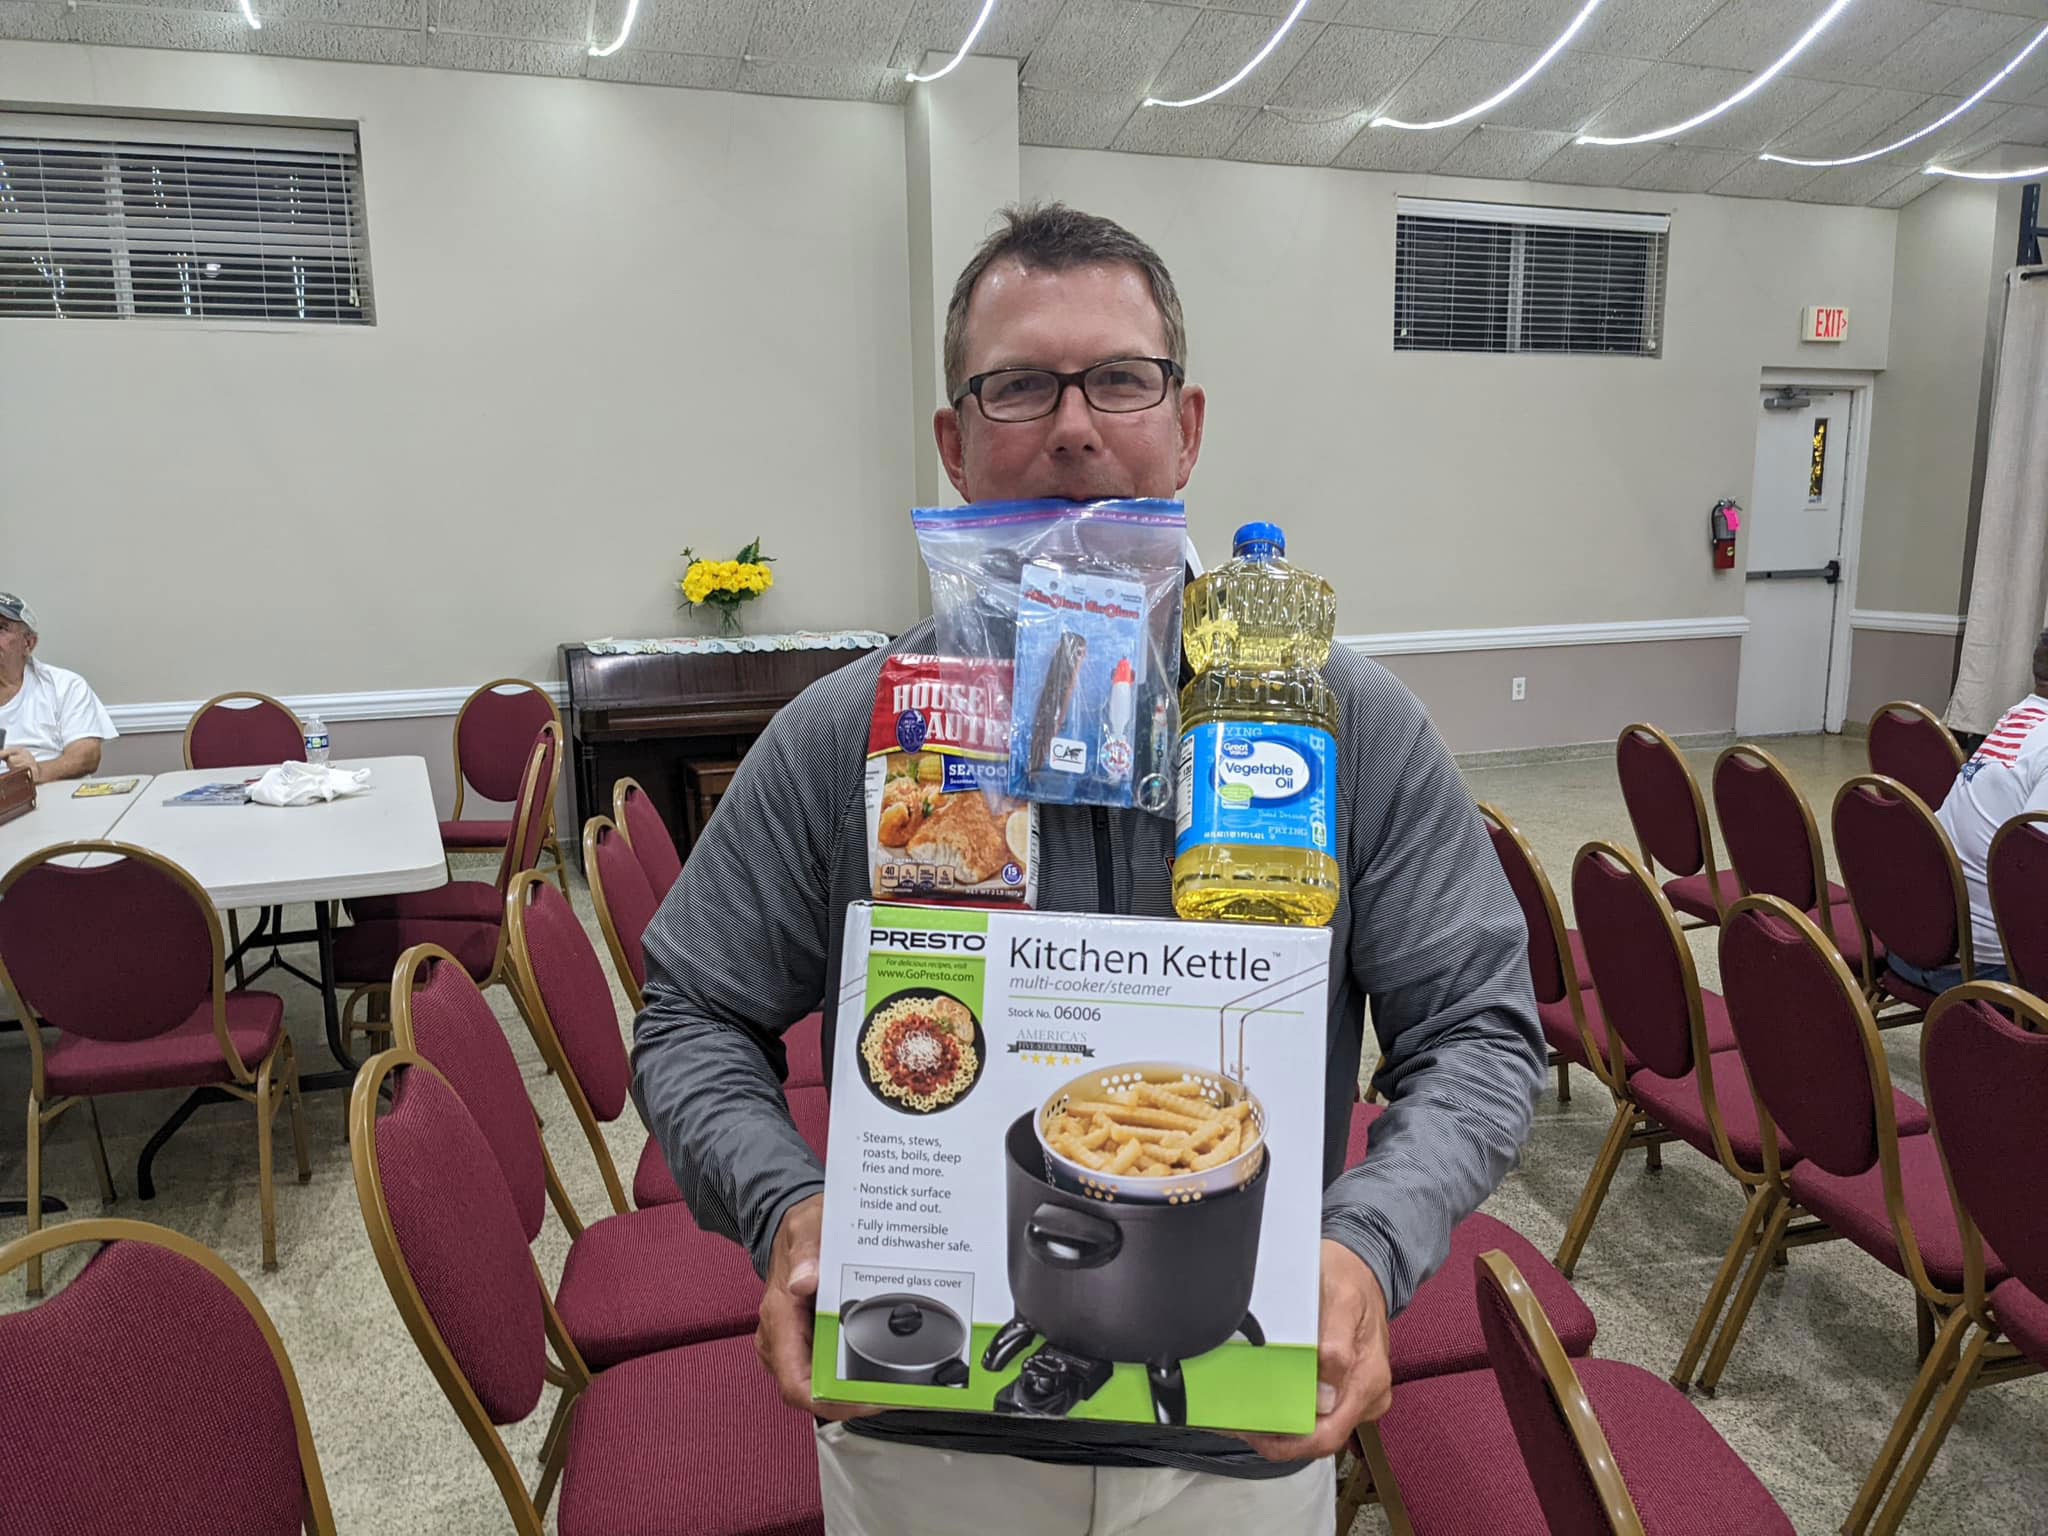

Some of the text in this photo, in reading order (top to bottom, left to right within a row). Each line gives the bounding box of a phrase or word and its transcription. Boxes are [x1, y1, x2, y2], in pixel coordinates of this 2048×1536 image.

[1815, 308, 1844, 337] EXIT
[893, 682, 982, 714] HOUSE
[925, 711, 1009, 748] AUTR
[1223, 742, 1248, 752] Great
[948, 764, 1008, 778] SEAFOO
[1225, 762, 1293, 777] Vegetable
[1275, 777, 1293, 789] Oil
[885, 866, 895, 876] 40
[1007, 866, 1018, 876] 15
[870, 929, 986, 952] PRESTO
[886, 958, 897, 966] For
[1009, 936, 1271, 982] Kitchen Kettle
[877, 968, 975, 982] www.GoPresto.com
[1009, 976, 1172, 997] multi-cooker/steamer
[1008, 1005, 1101, 1022] Stock No. 06006
[1016, 1029, 1088, 1042] AMERICA'S
[863, 1131, 942, 1148] Steams, stews,
[863, 1148, 962, 1164] roasts, boils, deep
[862, 1161, 944, 1177] fries and more.
[860, 1183, 951, 1199] Nonstick surface
[859, 1198, 942, 1214] inside and out.
[857, 1218, 949, 1235] Fully immersible
[857, 1235, 973, 1252] and dishwasher safe.
[853, 1271, 962, 1289] Tempered glass cover
